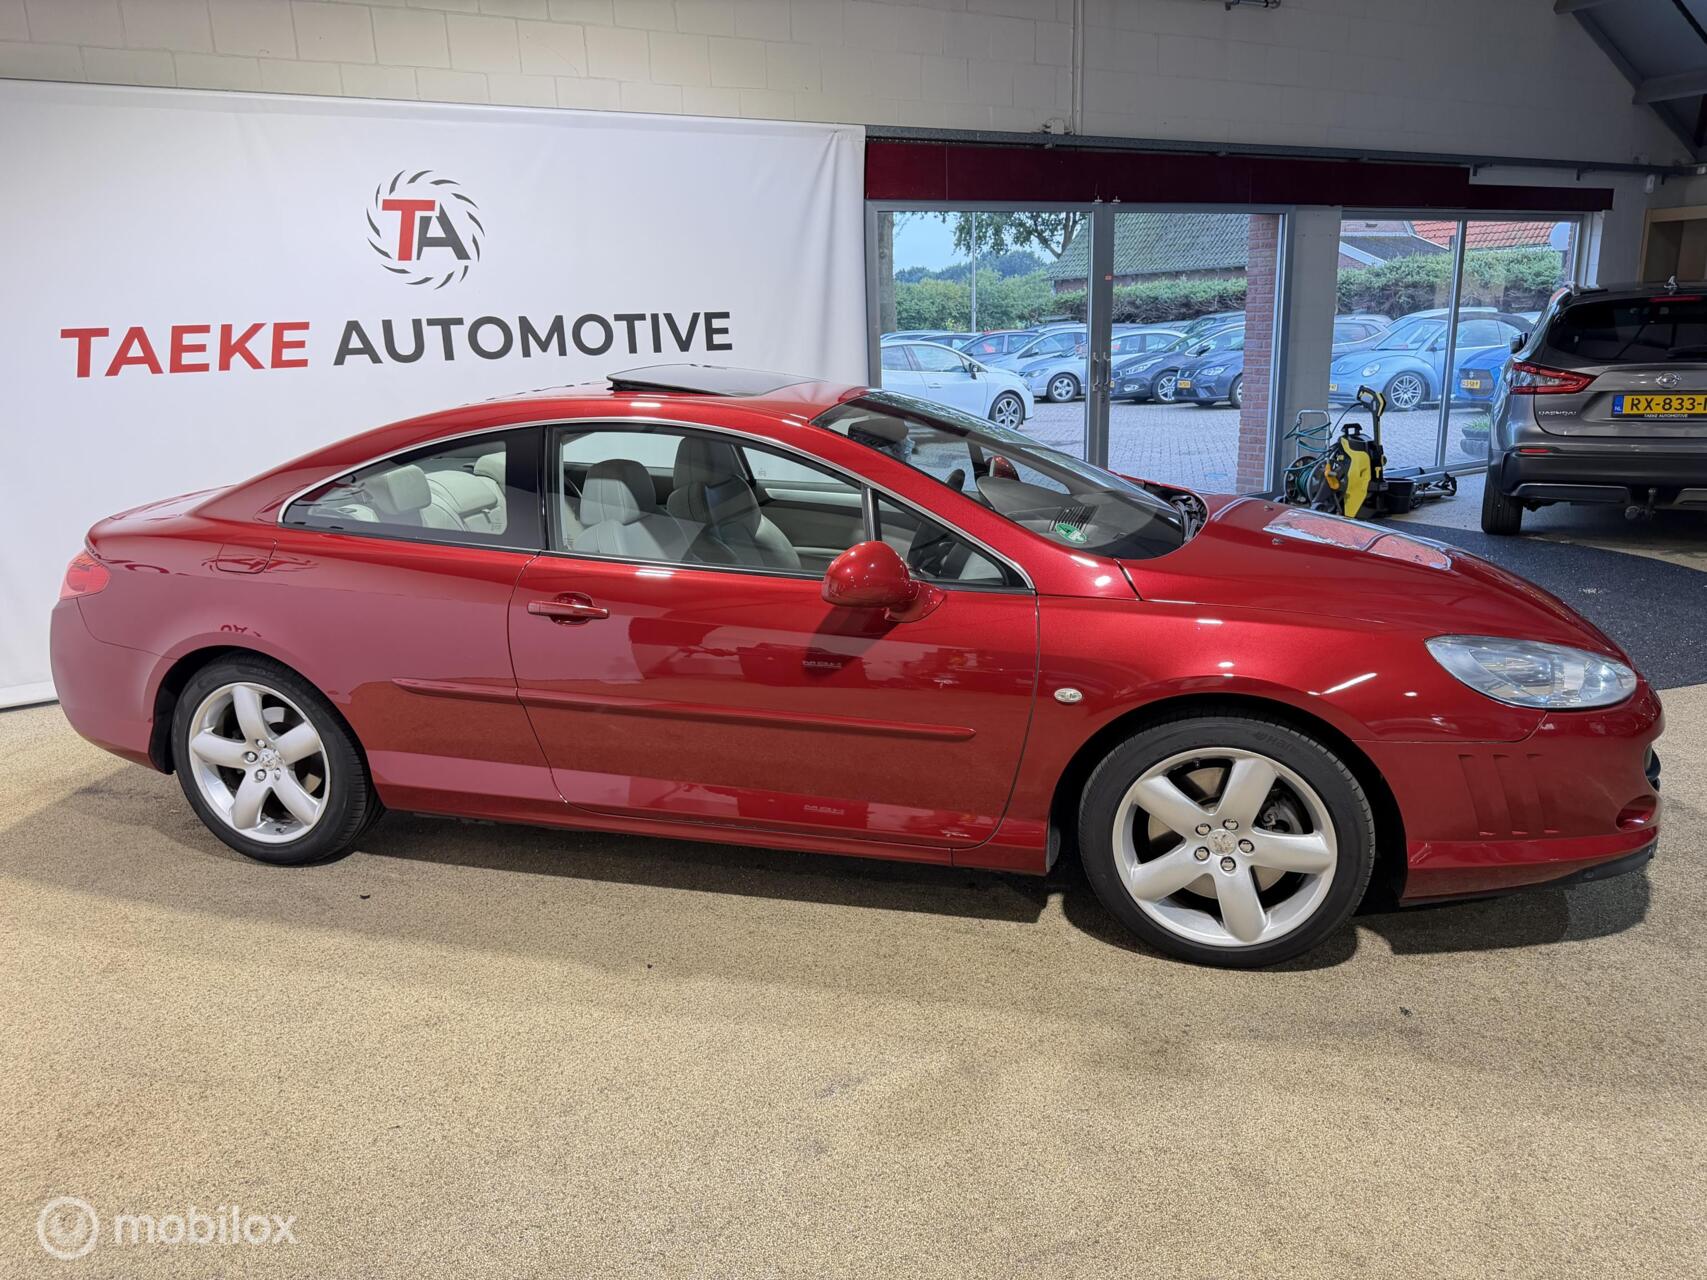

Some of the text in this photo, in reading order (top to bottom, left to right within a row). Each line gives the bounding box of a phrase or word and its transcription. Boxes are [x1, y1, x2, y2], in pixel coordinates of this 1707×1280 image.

[382, 199, 472, 262] TA
[60, 311, 733, 378] TAEKE AUTOMOTIVE
